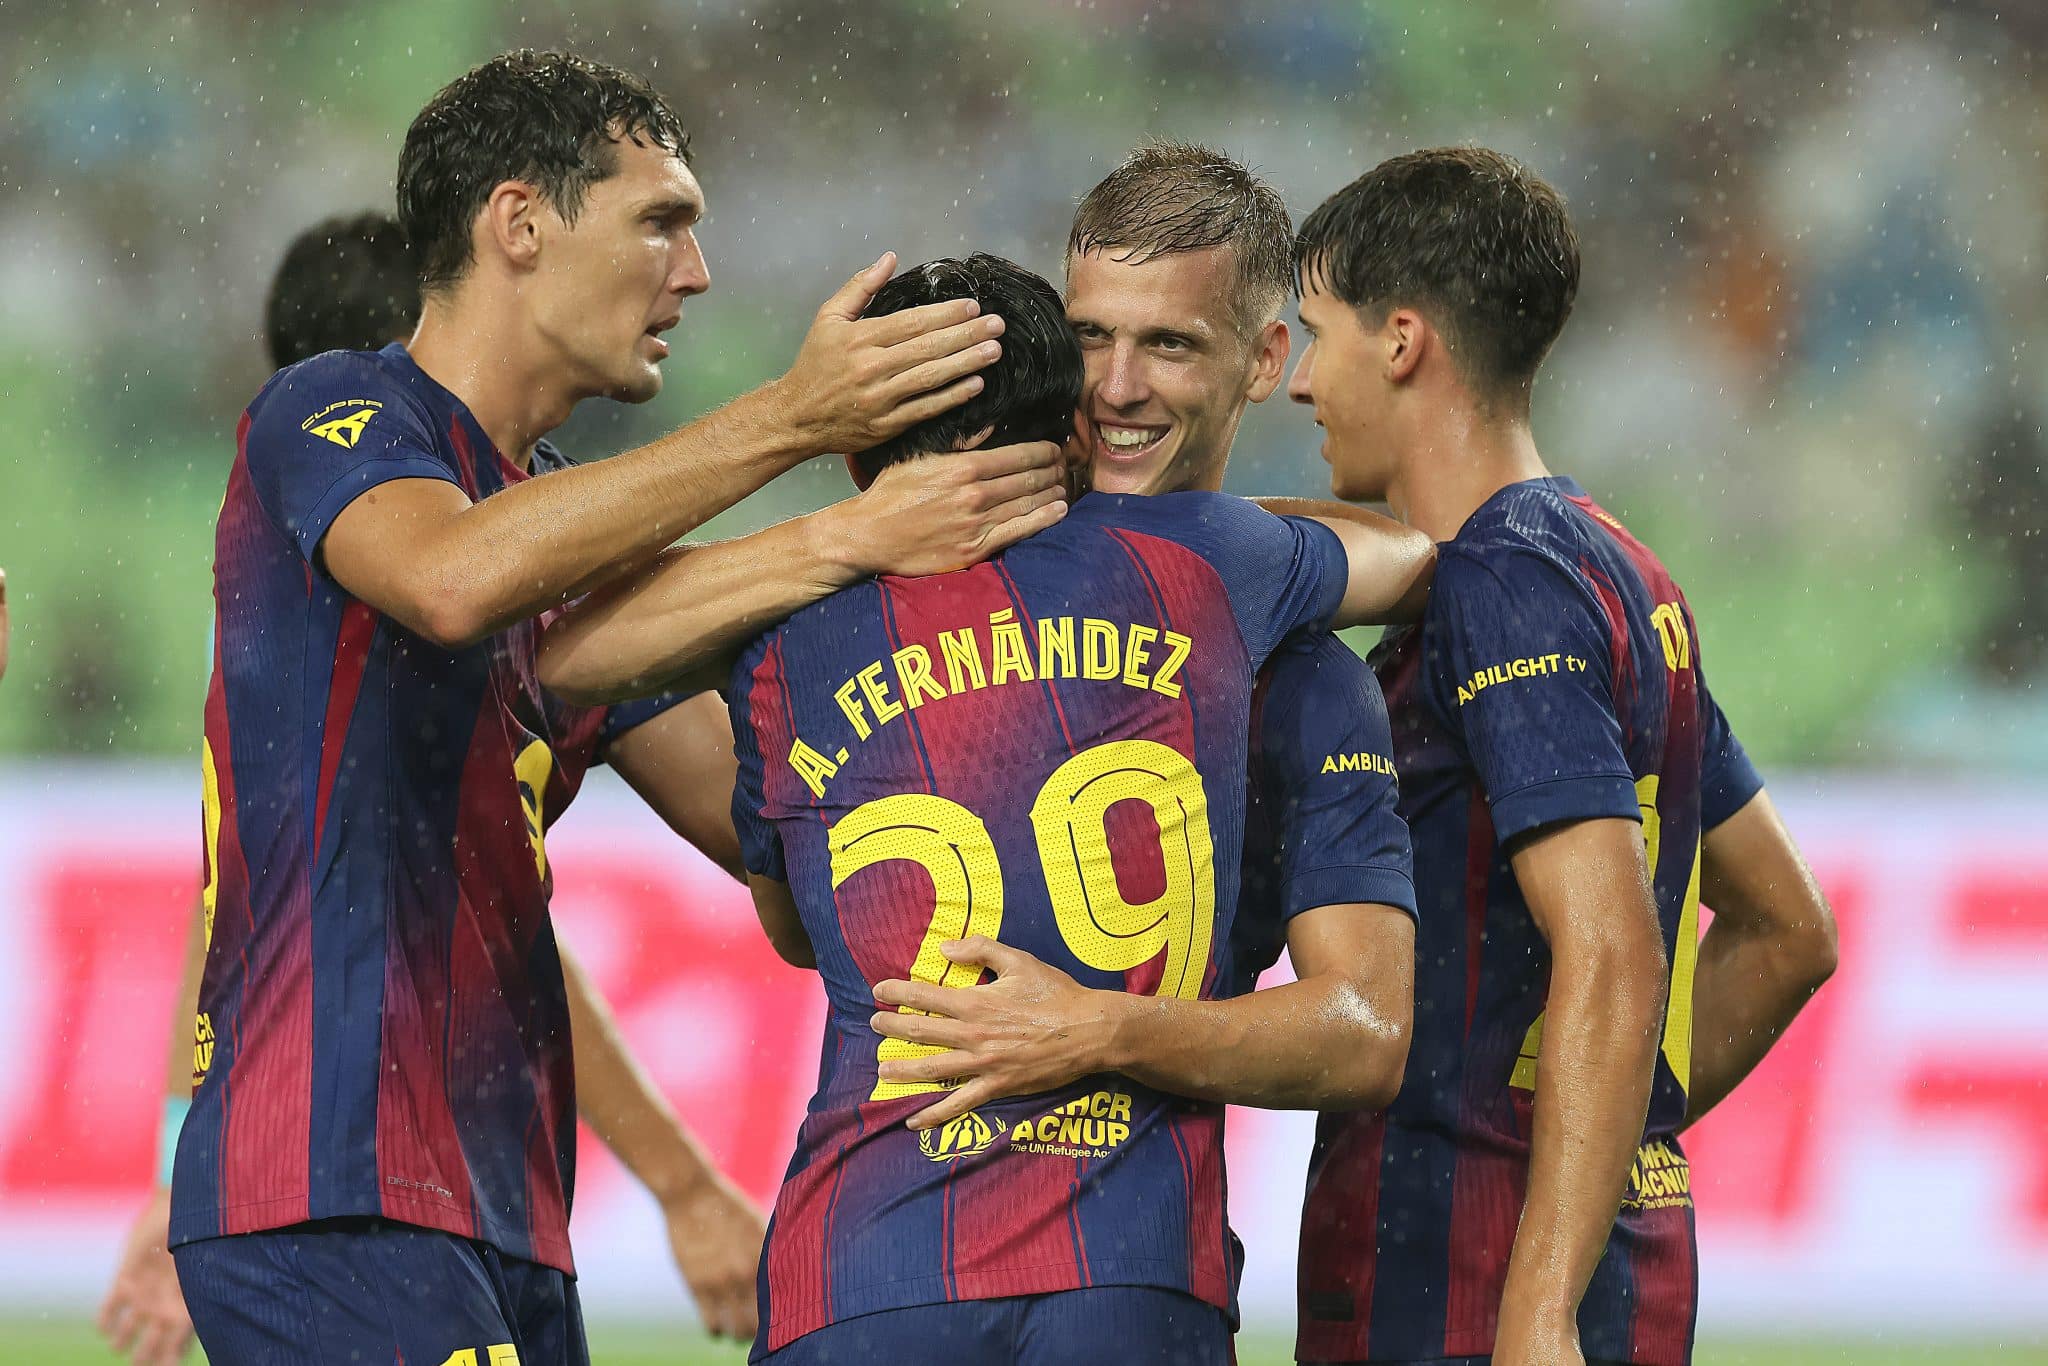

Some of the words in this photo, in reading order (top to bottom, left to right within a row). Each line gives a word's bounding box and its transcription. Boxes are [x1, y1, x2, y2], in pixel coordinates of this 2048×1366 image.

[302, 399, 383, 431] CUPRA
[1565, 654, 1587, 673] tv
[787, 737, 850, 799] A.
[834, 607, 1192, 742] FERNÁNDEZ
[827, 739, 1216, 1102] 29
[1010, 1143, 1028, 1152] The
[1028, 1142, 1046, 1153] UN
[1046, 1144, 1092, 1158] Refugee
[1640, 1166, 1690, 1198] ACNU
